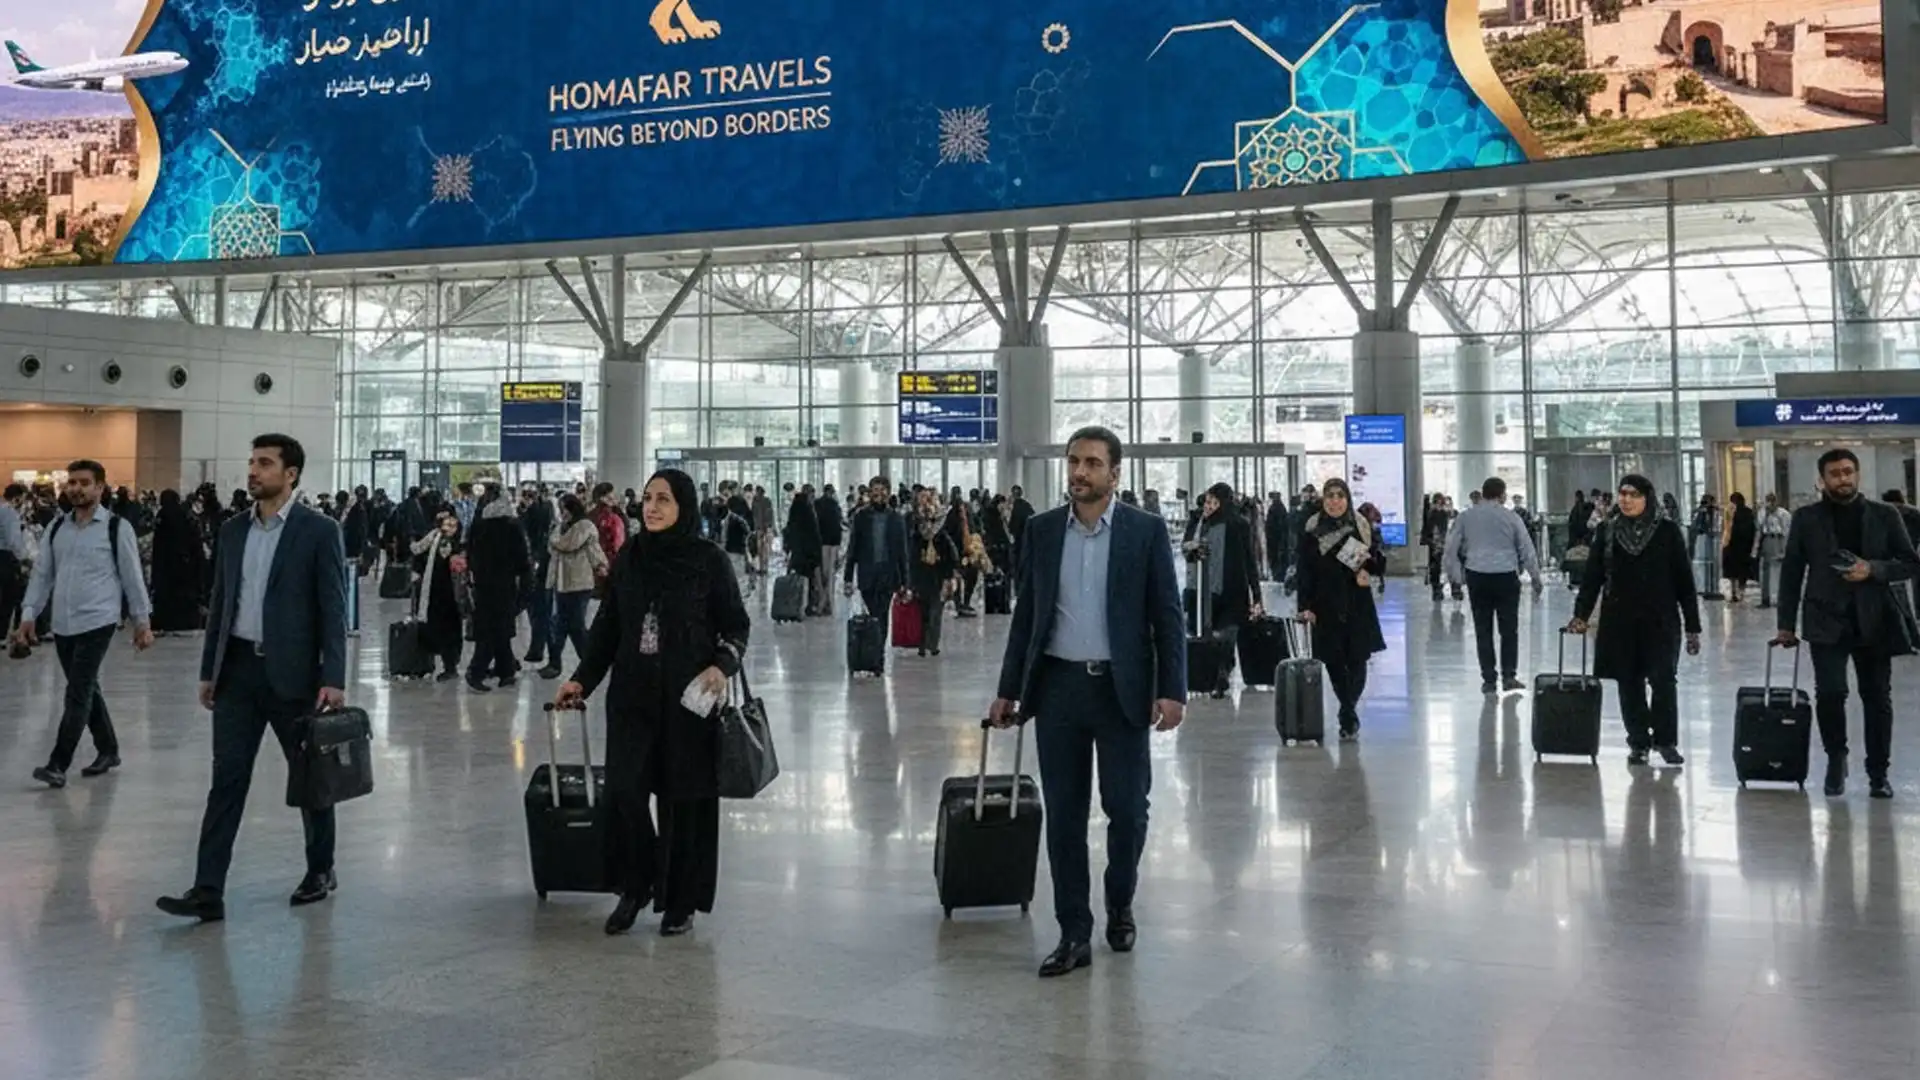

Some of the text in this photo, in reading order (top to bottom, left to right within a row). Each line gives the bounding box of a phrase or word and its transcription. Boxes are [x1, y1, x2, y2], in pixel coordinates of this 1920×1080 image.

[549, 55, 832, 112] HOMAFAR TRAVELS
[551, 105, 832, 151] FLYING BEYOND BORDERS
